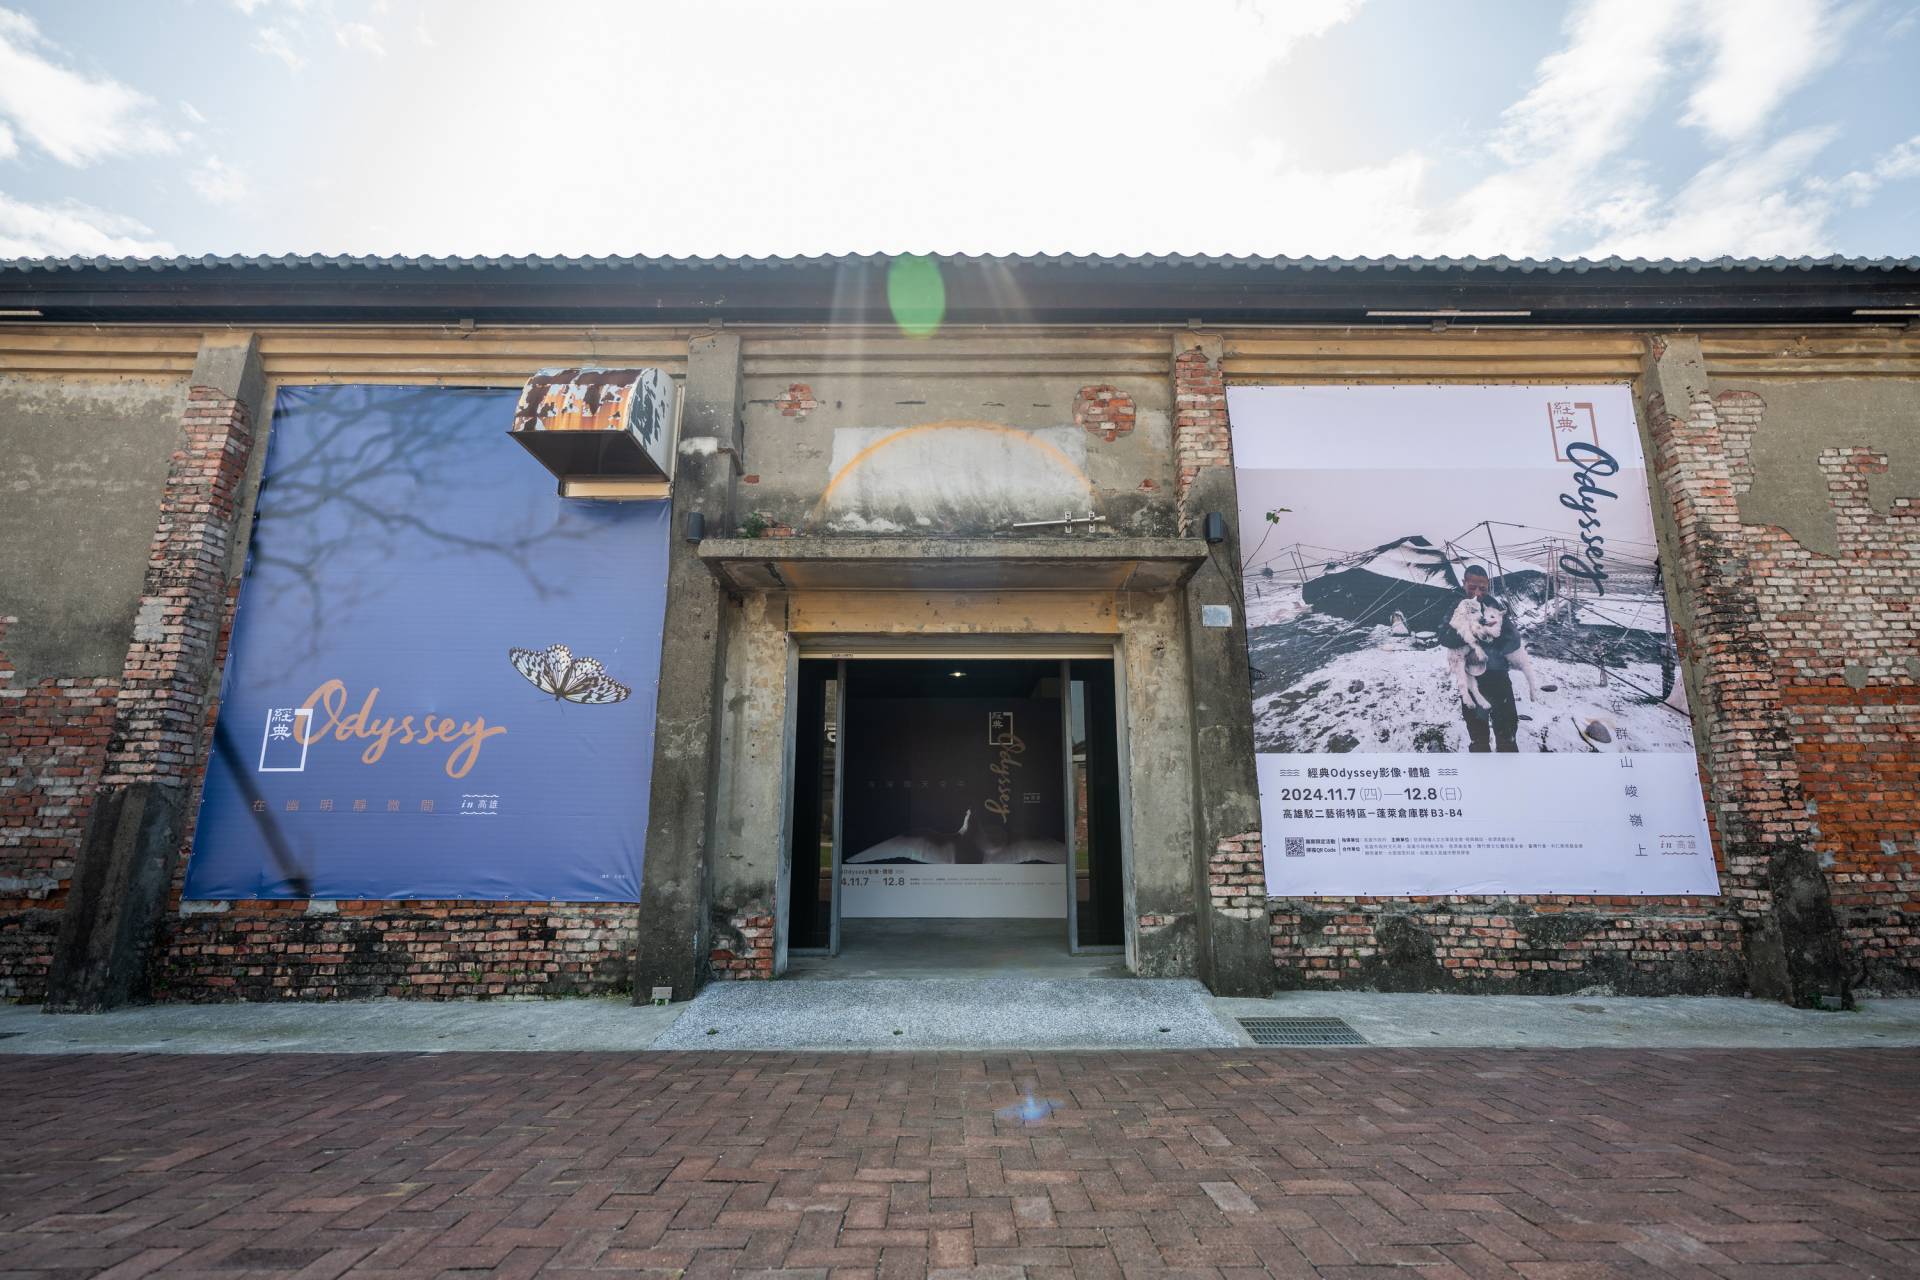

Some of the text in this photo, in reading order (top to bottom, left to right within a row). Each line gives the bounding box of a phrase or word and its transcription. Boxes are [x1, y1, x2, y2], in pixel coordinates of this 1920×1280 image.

[1553, 401, 1577, 432] 經典
[1559, 442, 1619, 596] Odyssey
[269, 709, 295, 740] 經典
[293, 678, 507, 779] Odyssey
[985, 733, 1026, 823] Odyssey
[461, 799, 499, 809] in 高雄
[1431, 808, 1463, 818] B3-B4
[883, 876, 905, 886] 12.8
